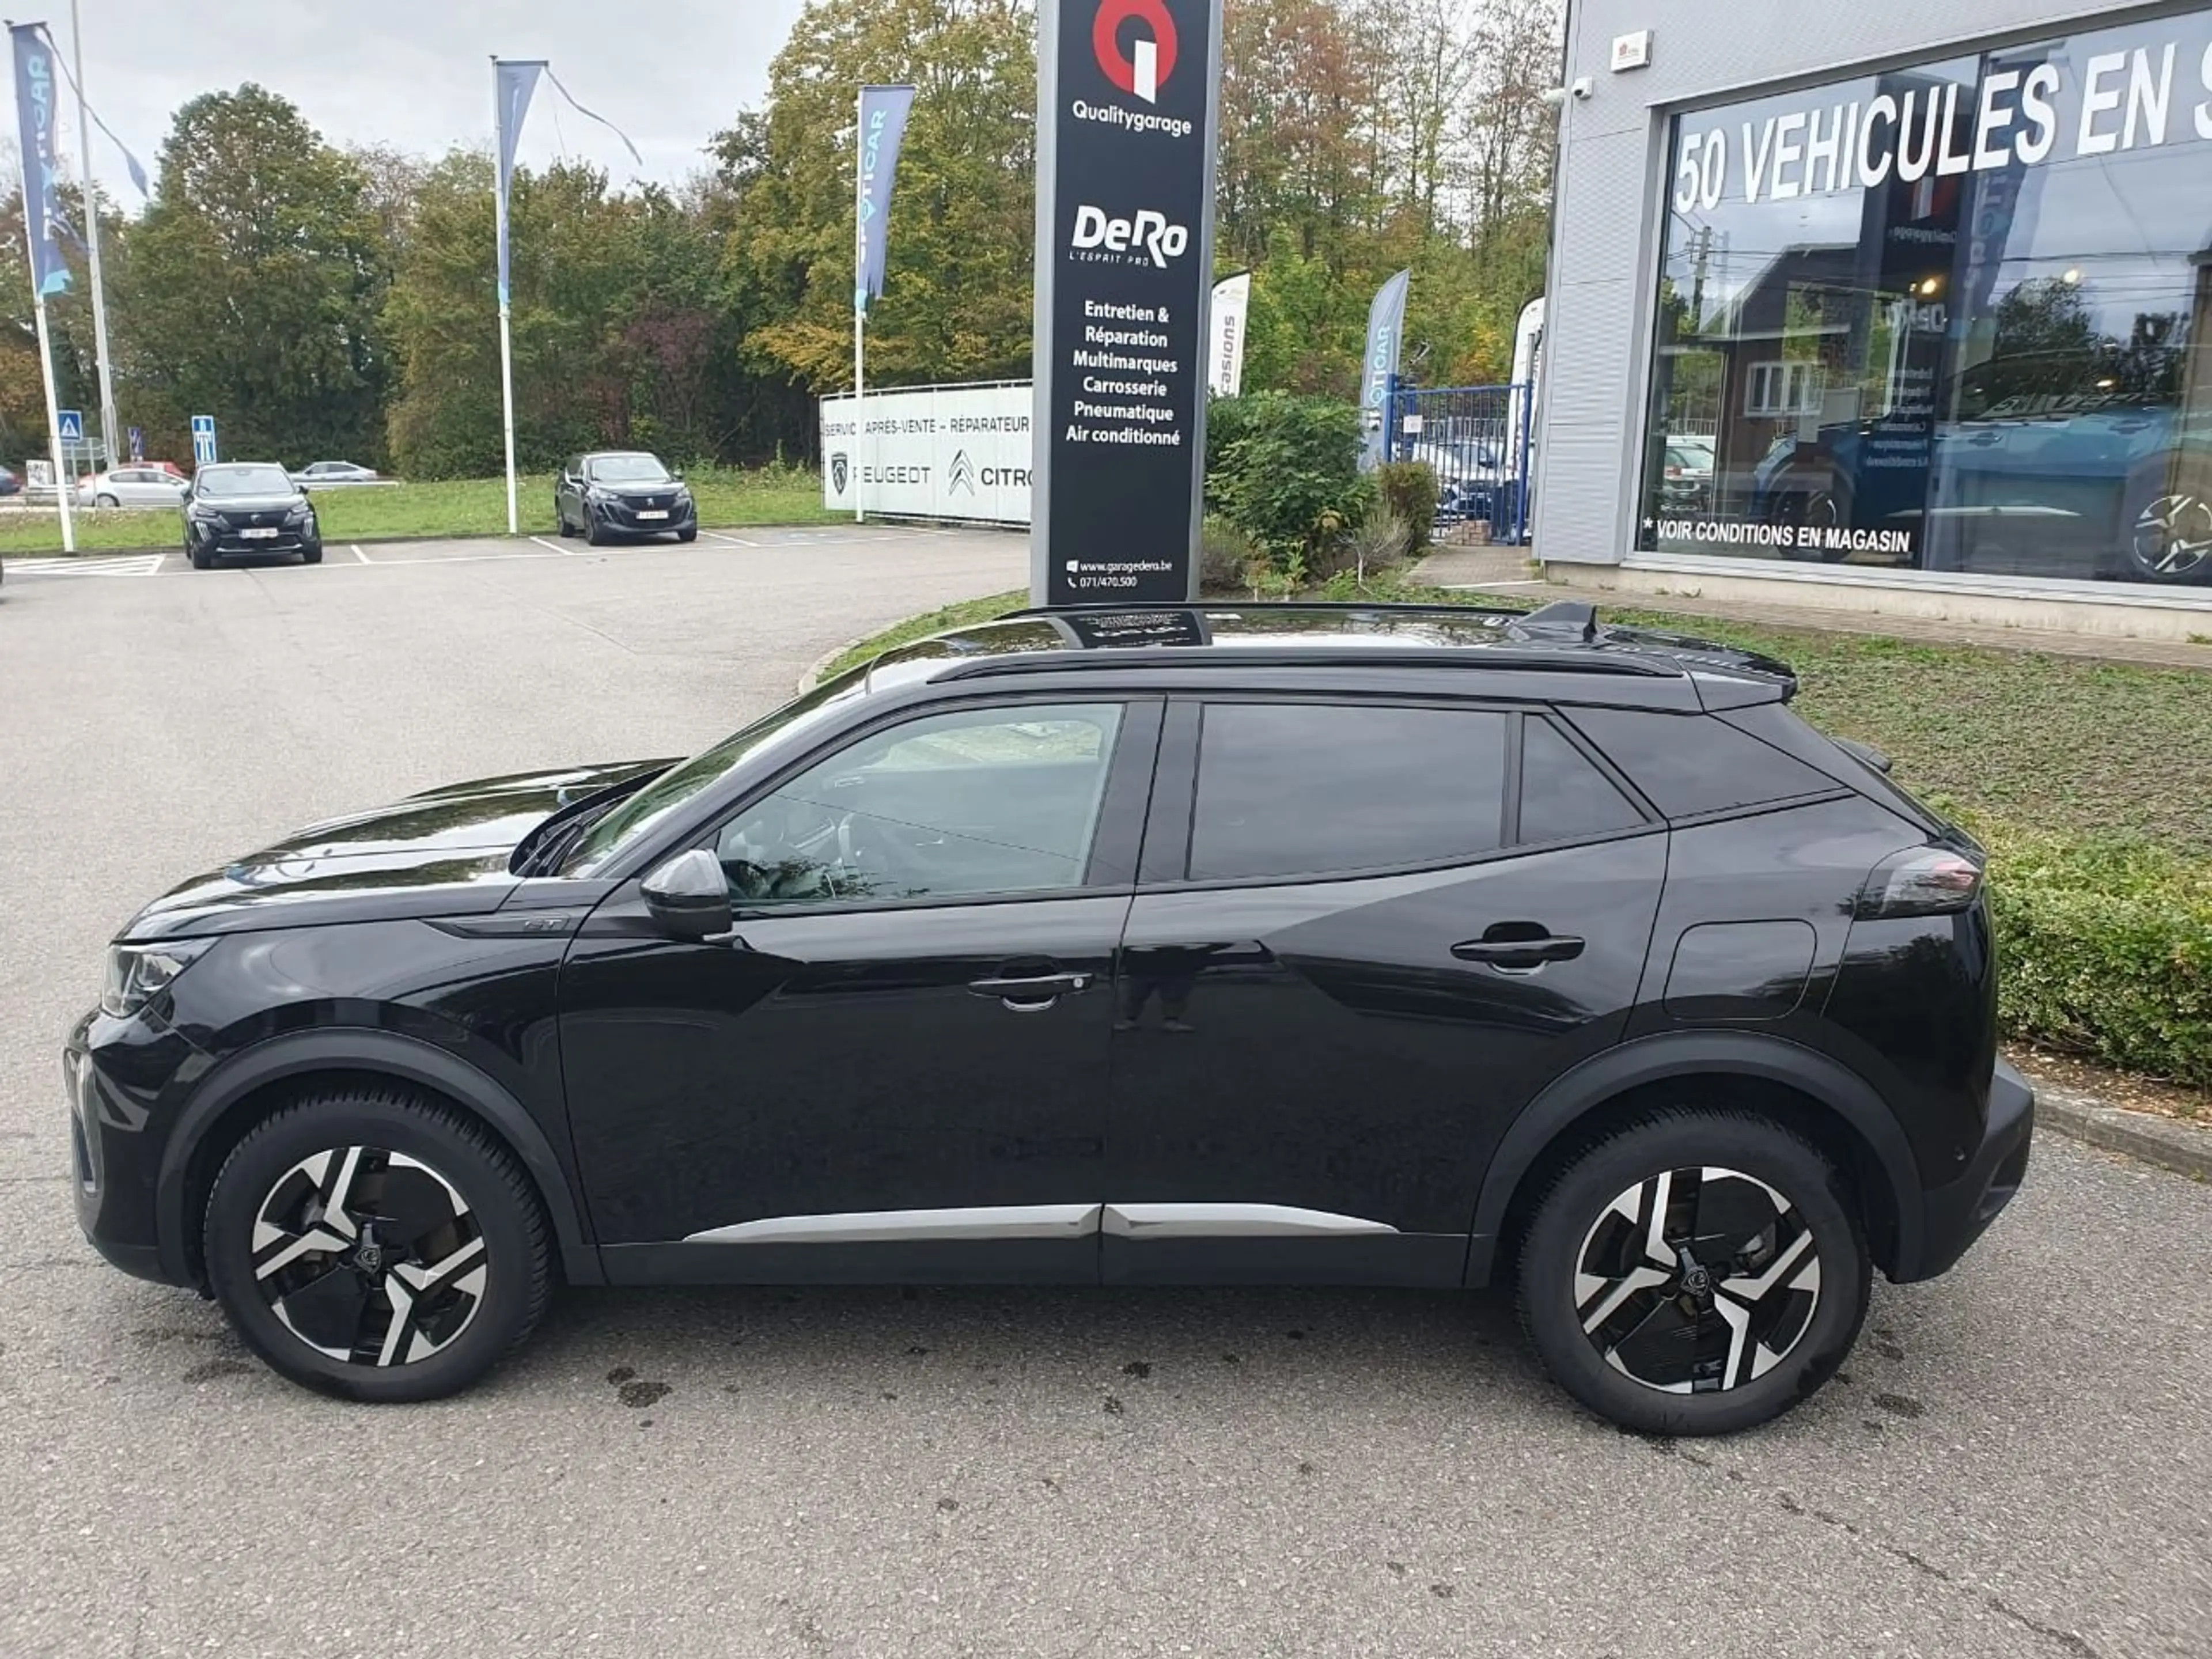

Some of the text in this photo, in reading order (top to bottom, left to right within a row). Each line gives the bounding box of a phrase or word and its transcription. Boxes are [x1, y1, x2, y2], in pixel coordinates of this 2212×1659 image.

[1073, 100, 1192, 138] Qualitygarage
[1676, 127, 1726, 214] 50
[1742, 63, 2061, 203] VEHICULES
[2076, 41, 2178, 155] EN
[1072, 205, 1188, 268] DeRo
[1085, 300, 1169, 323] Entretien &
[1085, 325, 1168, 348] Réparation
[1073, 349, 1178, 376] Multimarques
[1083, 376, 1168, 397] Carrosserie
[1074, 400, 1175, 424] Pneumatique
[826, 422, 857, 437] SERVIC
[950, 415, 1029, 433] RÉPARATEUR
[1066, 425, 1181, 445] Air conditionné
[853, 466, 931, 483] EUGEOT
[1657, 520, 1910, 552] VOIR CONDITIONS EN MAGASIN
